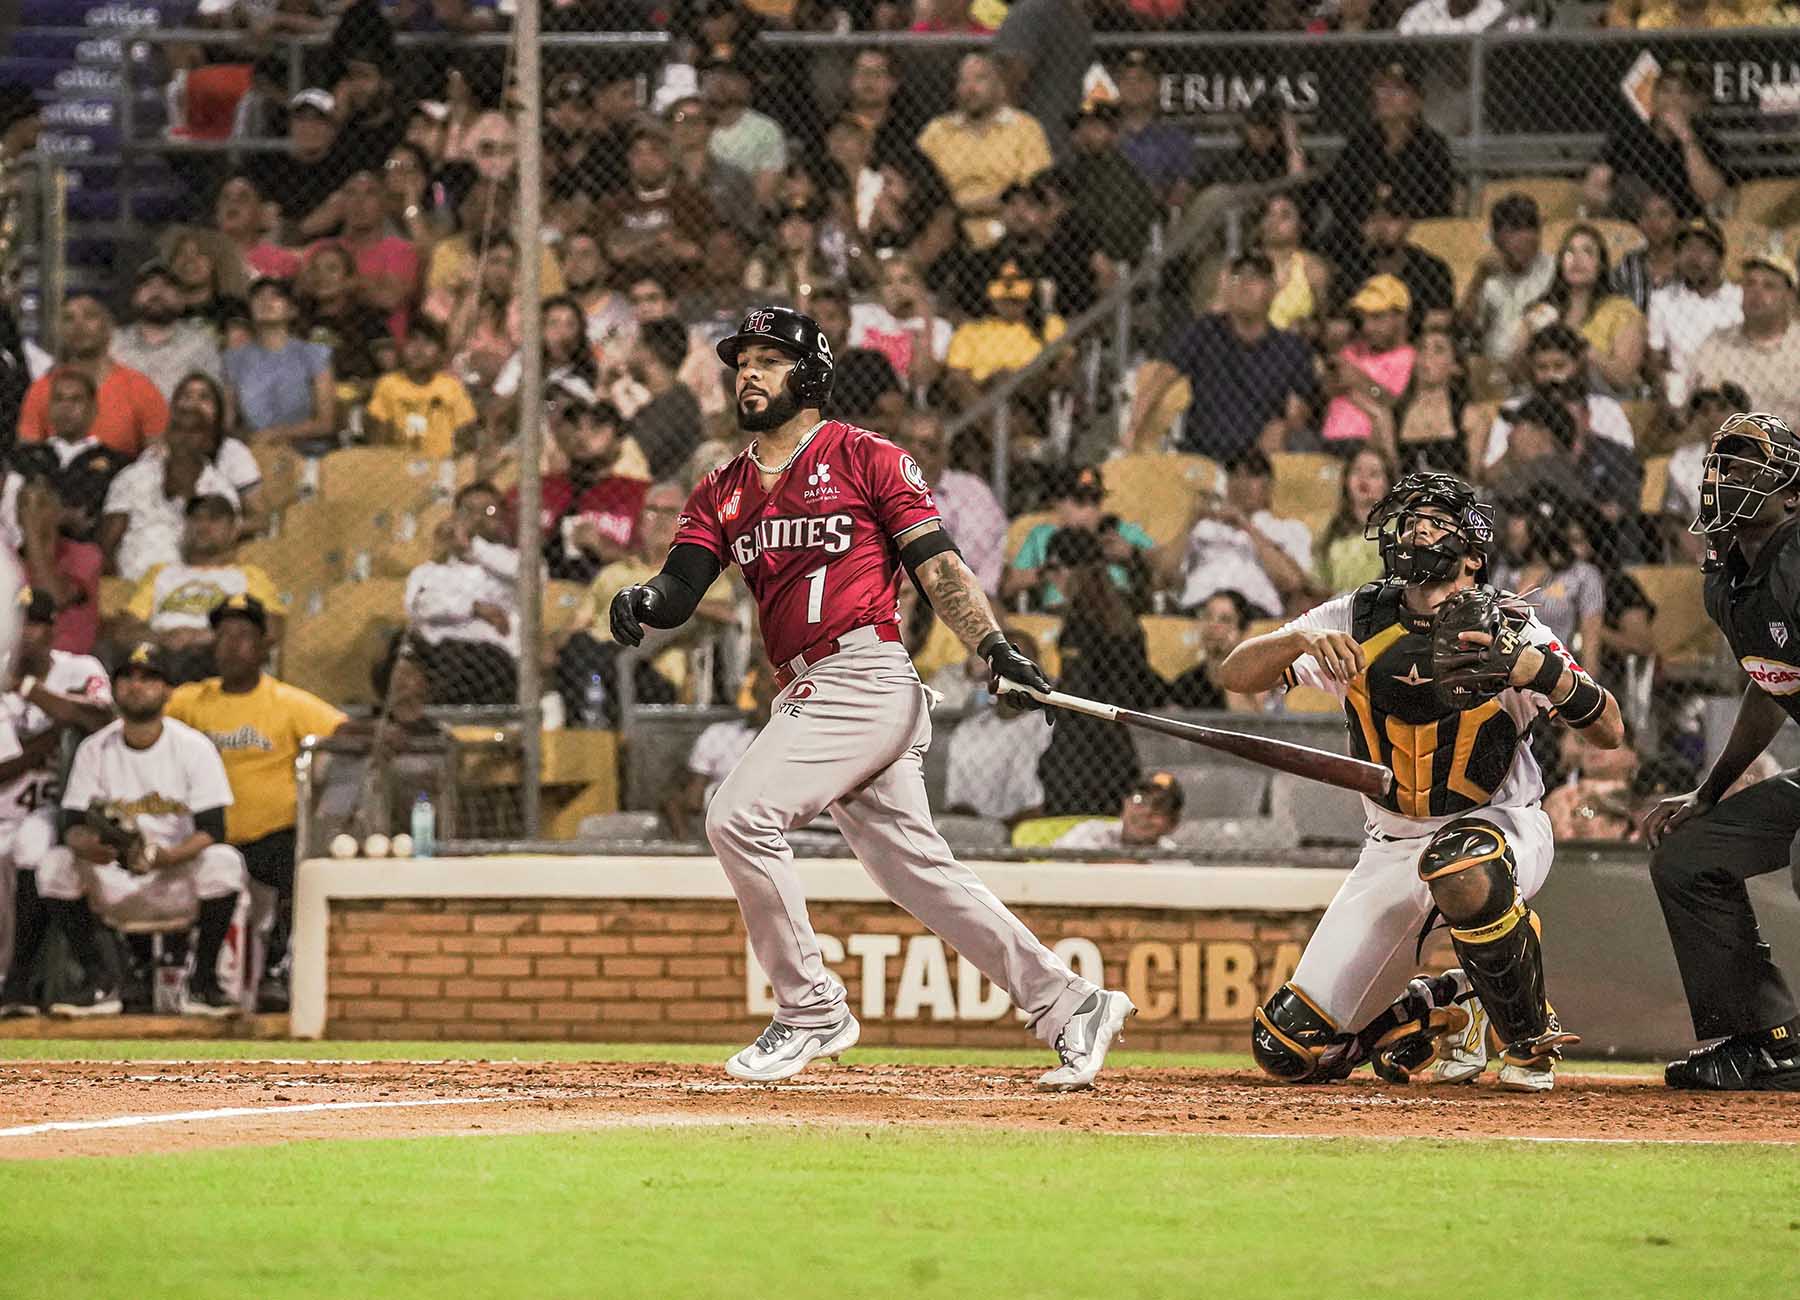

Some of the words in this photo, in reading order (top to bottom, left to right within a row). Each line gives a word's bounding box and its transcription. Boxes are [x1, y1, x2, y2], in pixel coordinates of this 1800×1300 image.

[730, 514, 853, 565] IGANTES
[805, 564, 828, 624] 1
[746, 933, 1105, 1021] ETADO
[1127, 942, 1303, 1022] CIBA
